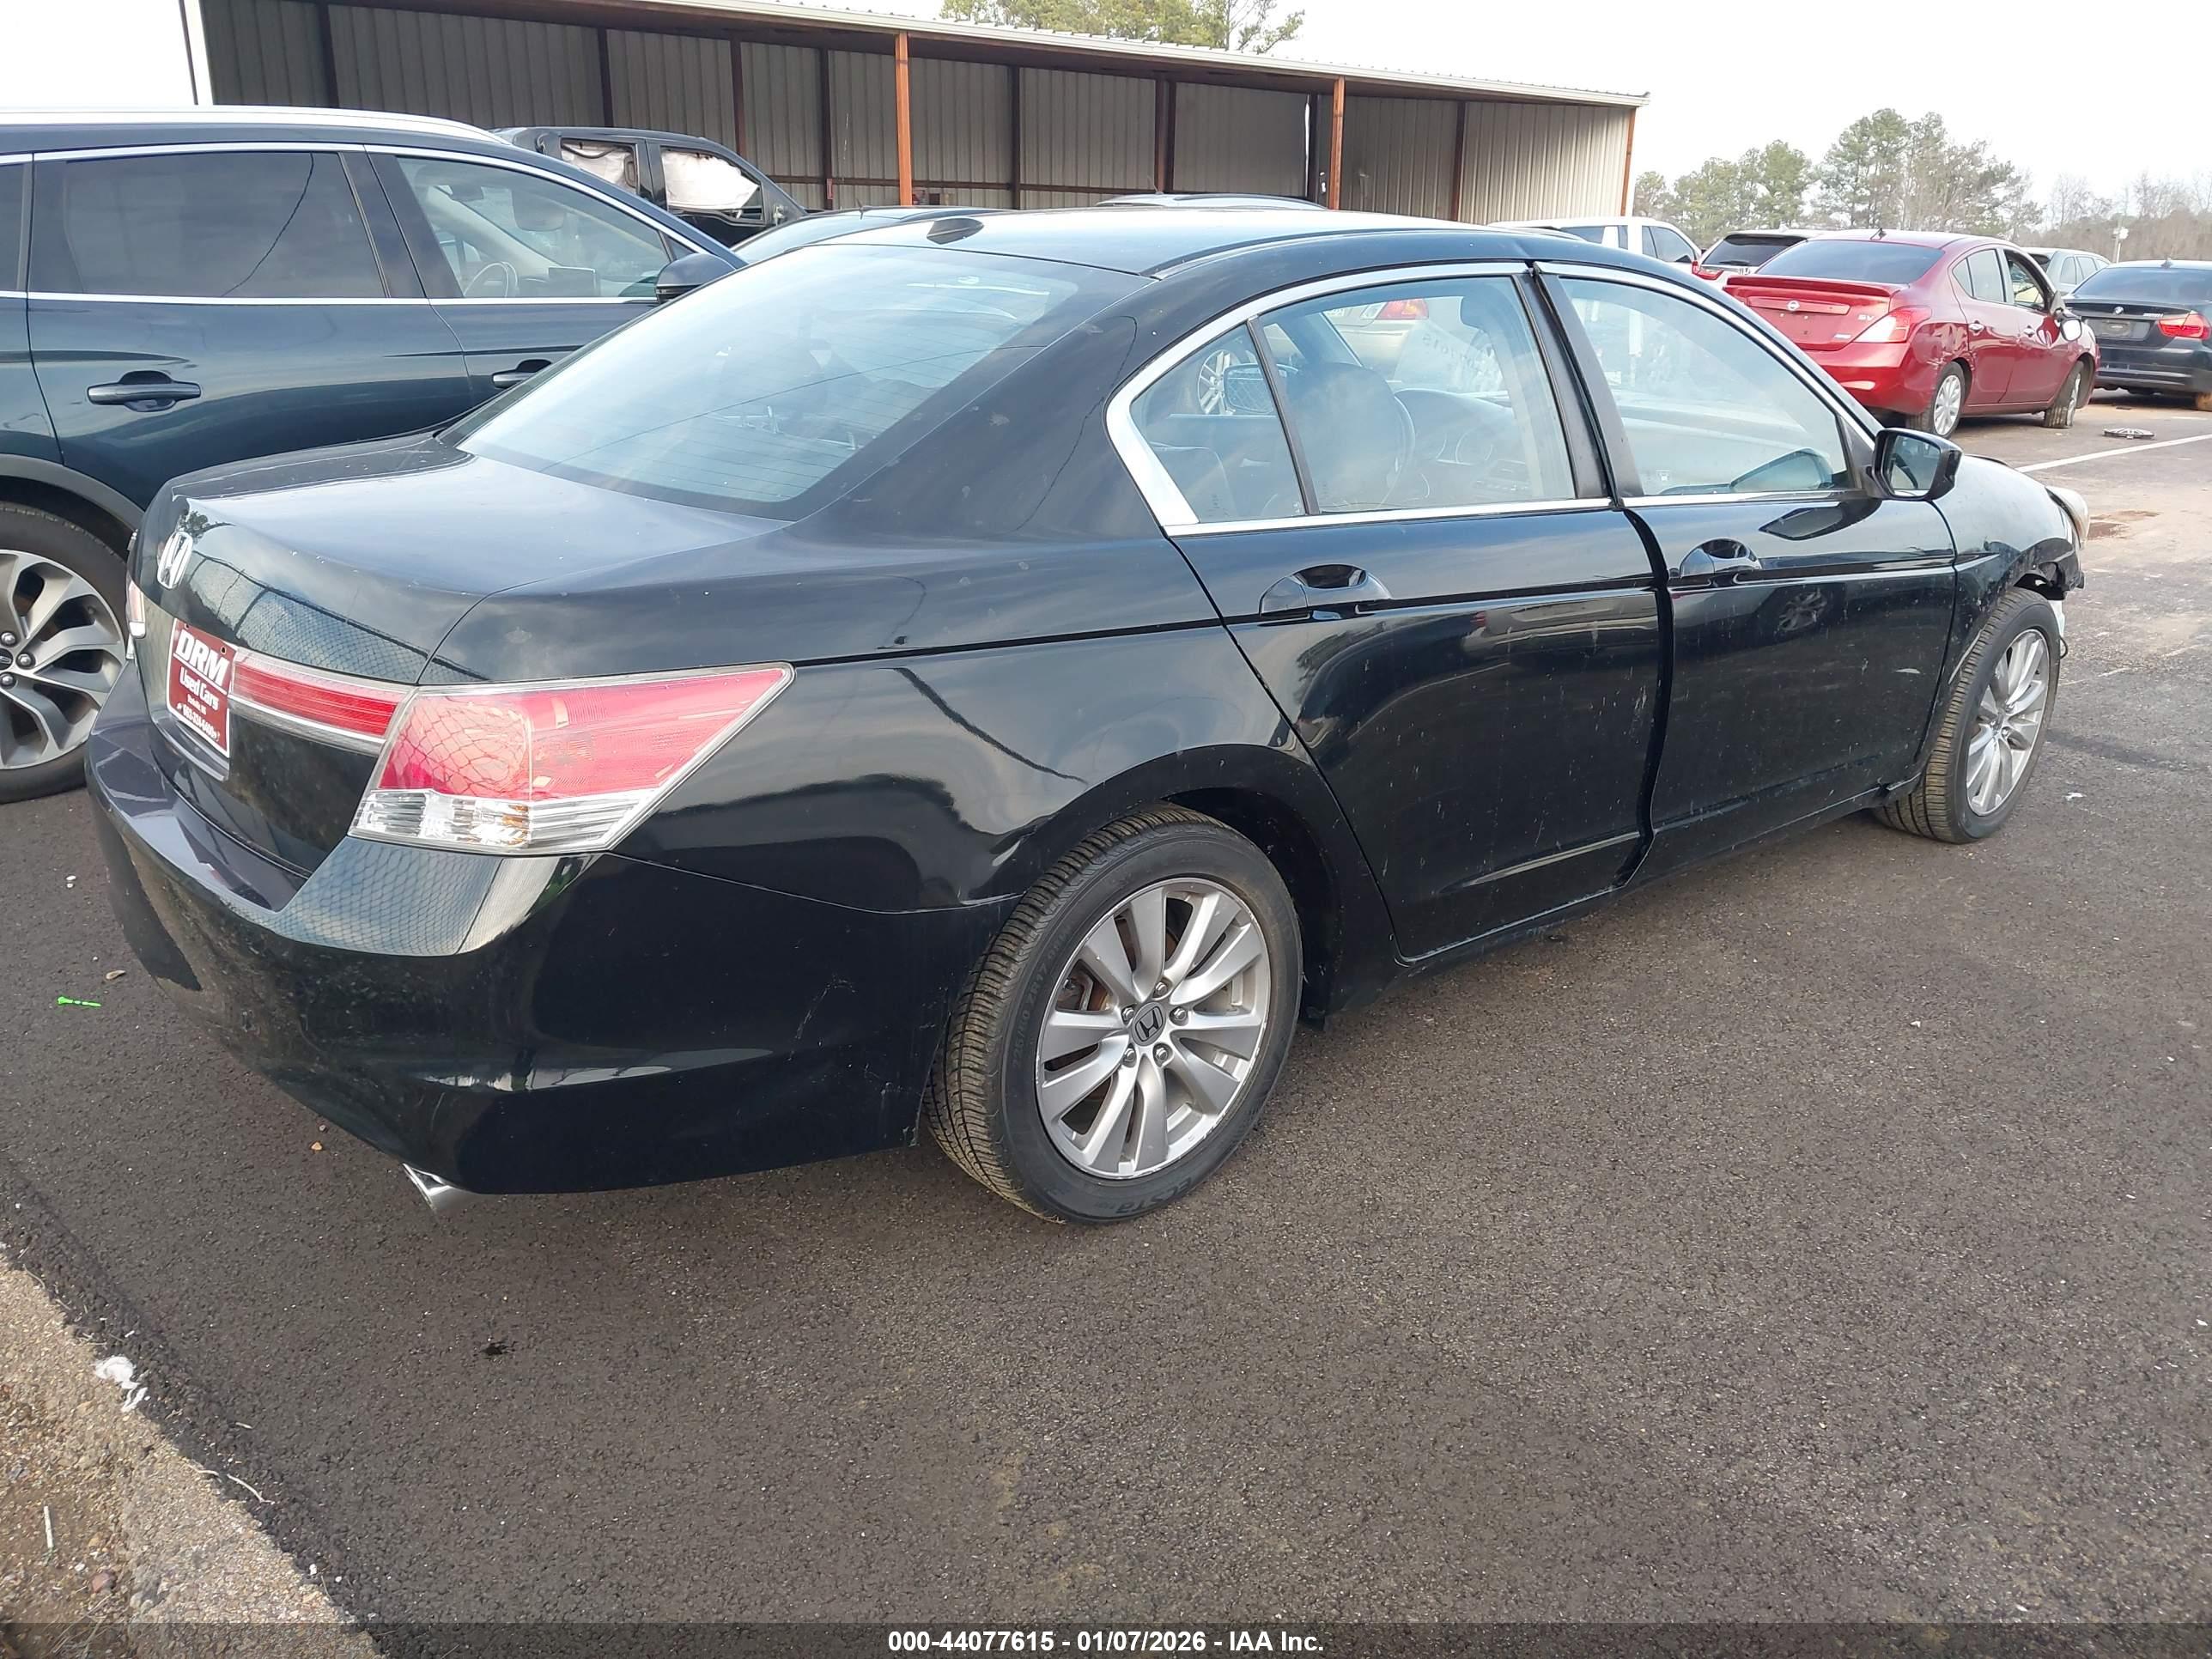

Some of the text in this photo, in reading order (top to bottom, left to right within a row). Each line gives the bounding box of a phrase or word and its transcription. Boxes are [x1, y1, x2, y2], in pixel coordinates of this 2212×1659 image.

[175, 629, 230, 687] DRM
[179, 666, 200, 696] Used
[199, 683, 220, 711] Cars
